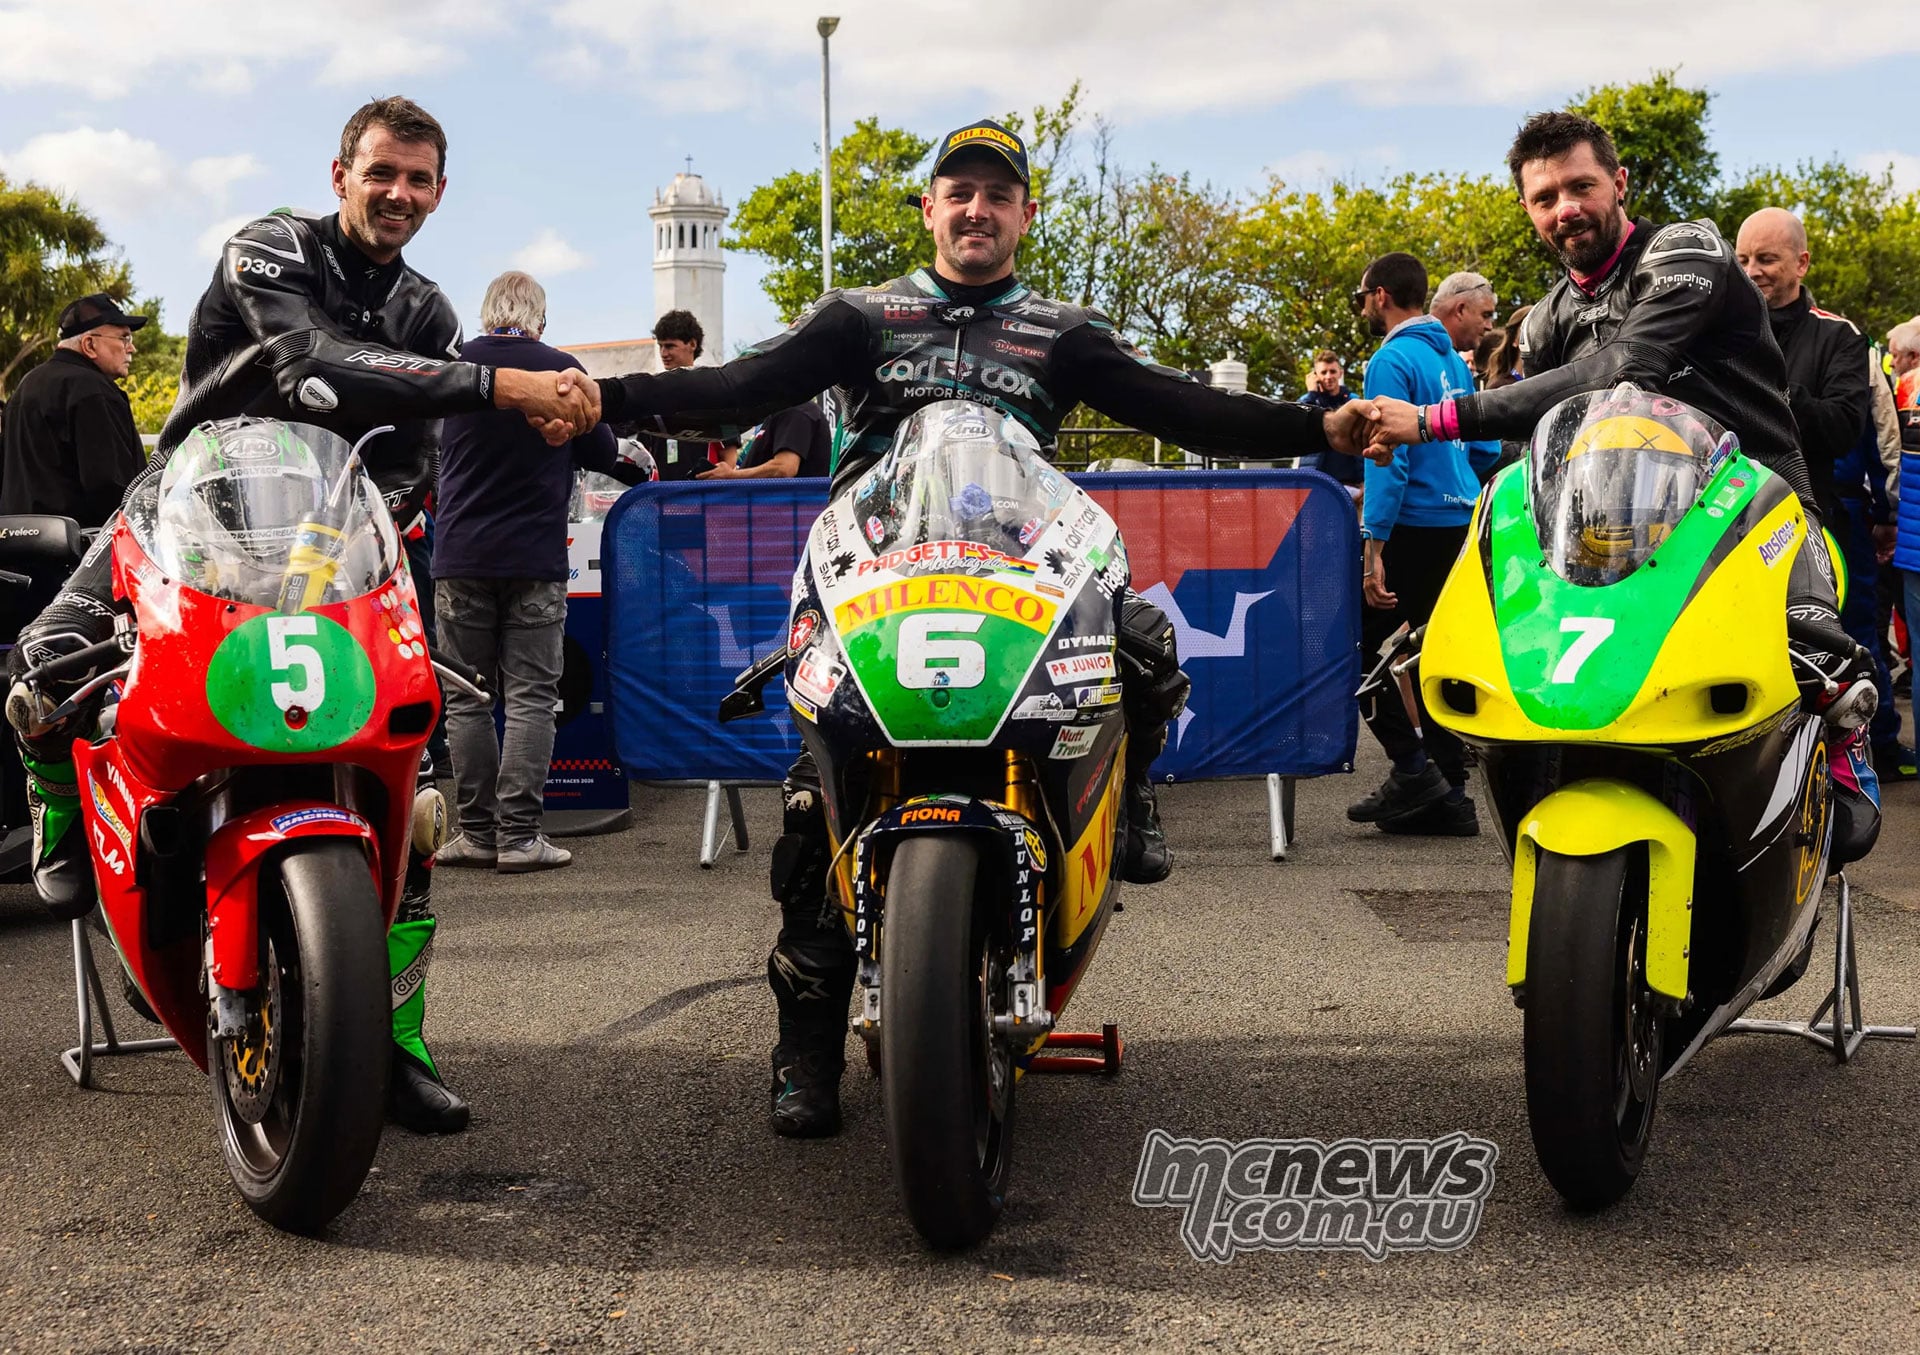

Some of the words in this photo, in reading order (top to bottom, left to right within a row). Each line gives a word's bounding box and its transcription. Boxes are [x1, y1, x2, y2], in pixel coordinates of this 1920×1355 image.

[951, 128, 1019, 149] MILENCO
[344, 350, 444, 370] RST
[479, 365, 491, 399] RST
[904, 387, 954, 398] MOTOR
[955, 389, 1000, 407] SPORT
[953, 422, 988, 434] Arai
[9, 527, 40, 537] veleco
[858, 540, 990, 577] PADGETT'S
[847, 580, 1044, 626] MILENCO
[897, 613, 986, 688] 6
[1058, 634, 1117, 650] DYMAG
[1551, 616, 1615, 683] 7
[266, 616, 326, 713] 5
[1051, 663, 1069, 677] PR
[1072, 655, 1113, 674] JUNIOR
[1058, 728, 1085, 743] Nutt
[901, 807, 961, 825] FIONA
[855, 842, 869, 951] DUNLOP
[1014, 832, 1036, 942] DUNLOP
